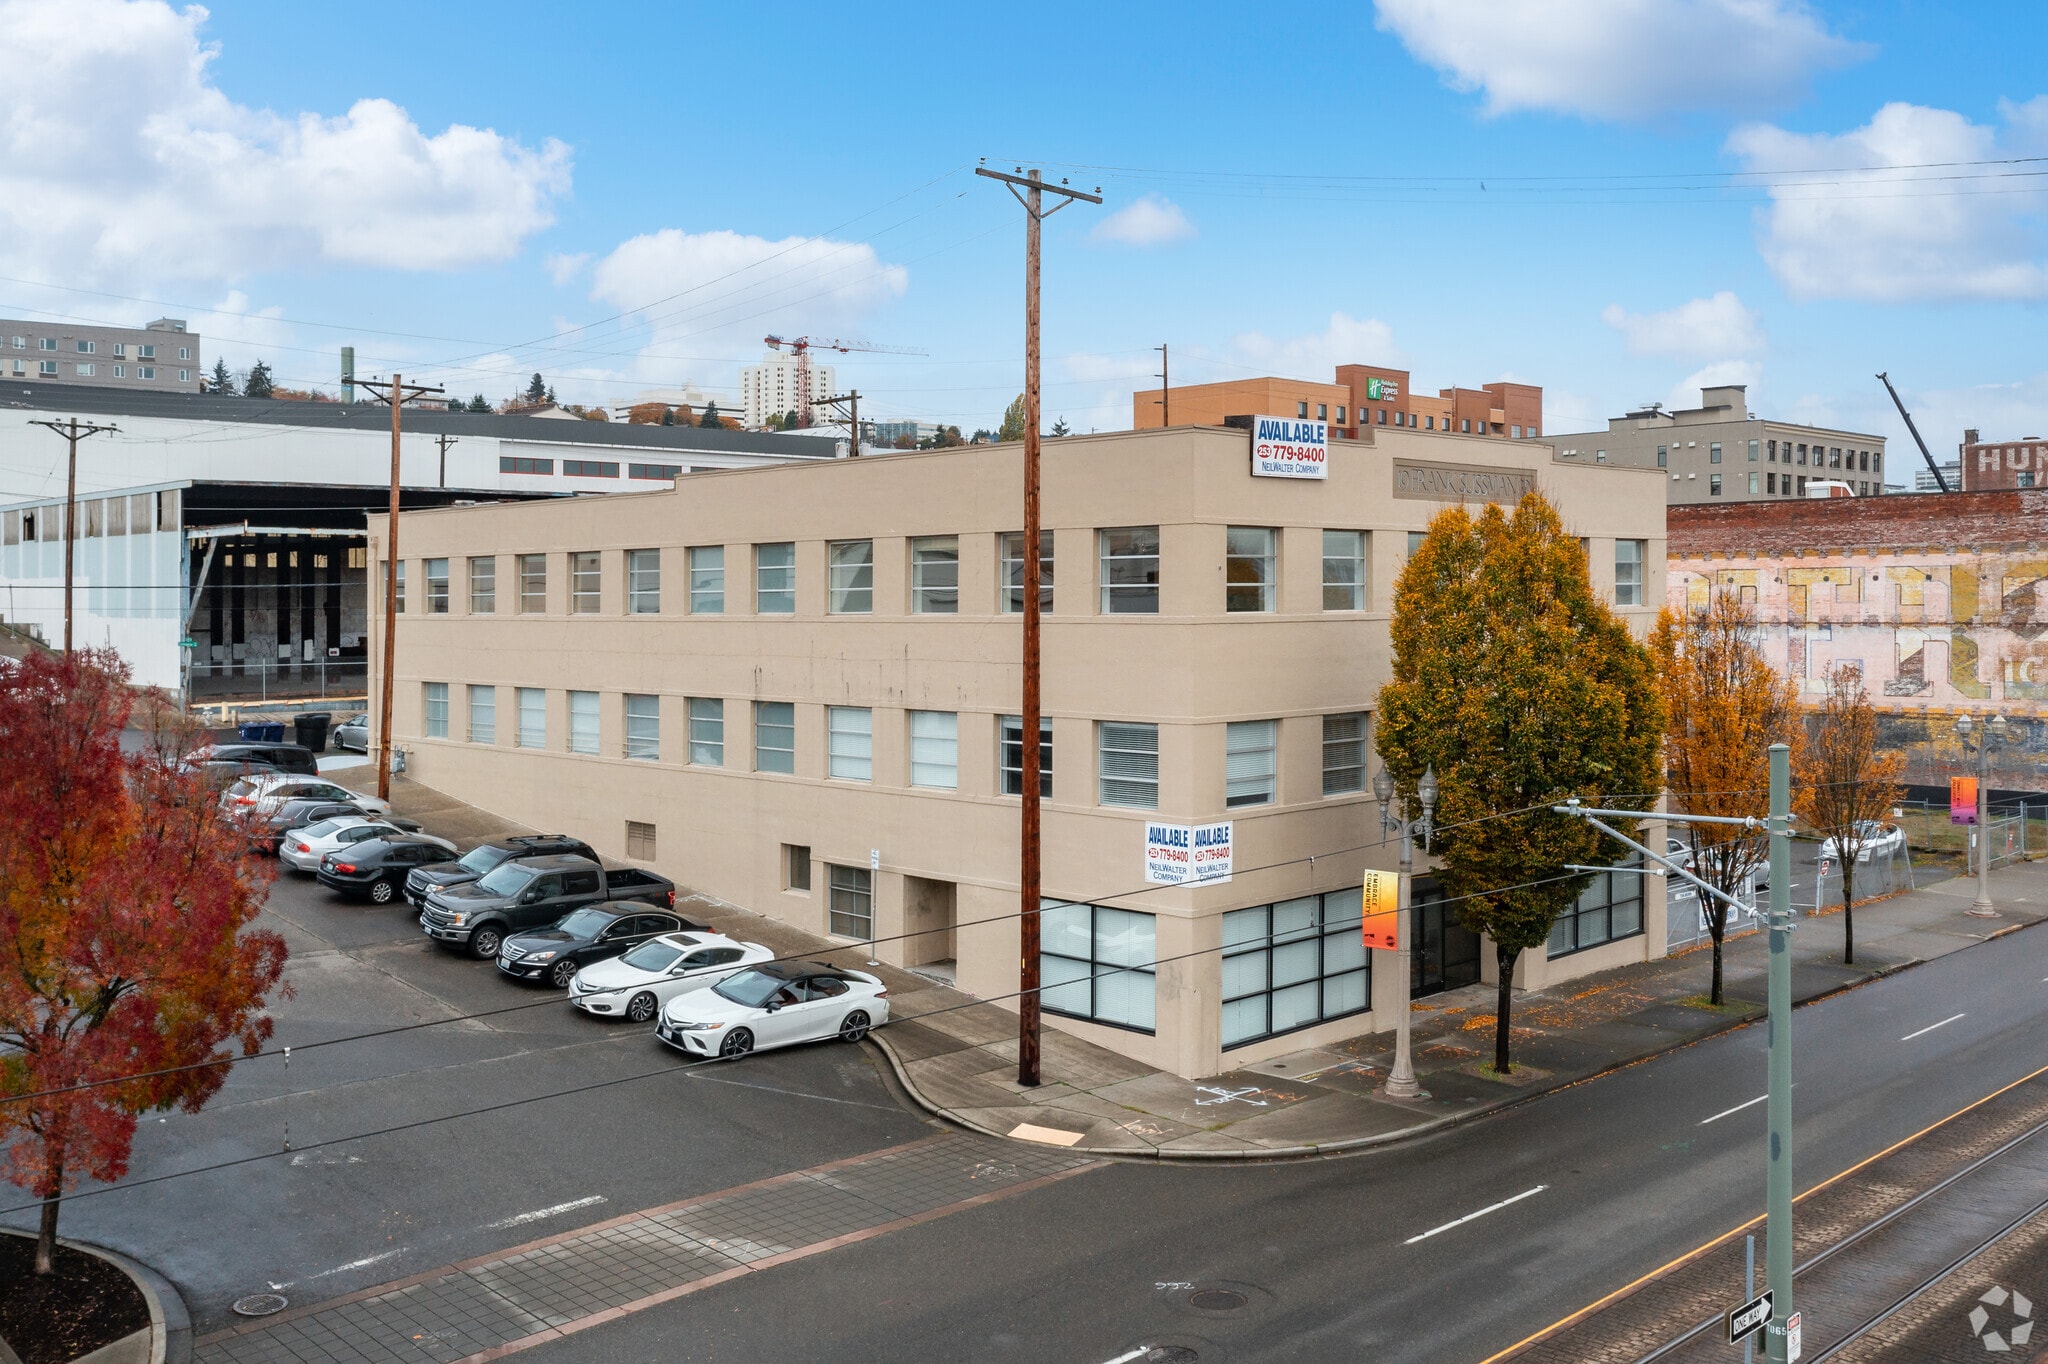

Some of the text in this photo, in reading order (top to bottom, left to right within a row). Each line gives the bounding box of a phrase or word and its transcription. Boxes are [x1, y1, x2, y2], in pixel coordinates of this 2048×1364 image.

[1381, 386, 1398, 395] Express
[1258, 420, 1324, 444] AVAILABLE
[1258, 446, 1271, 456] 253
[1411, 468, 1456, 494] FRANK
[1459, 472, 1518, 497] SUSSMAN
[1148, 826, 1189, 848] AVAILABLE
[1194, 826, 1229, 848] AVAILABLE
[1365, 872, 1373, 914] COMMUNITY
[1371, 873, 1379, 906] EMBRACE
[1735, 1307, 1761, 1333] ONE WAY
